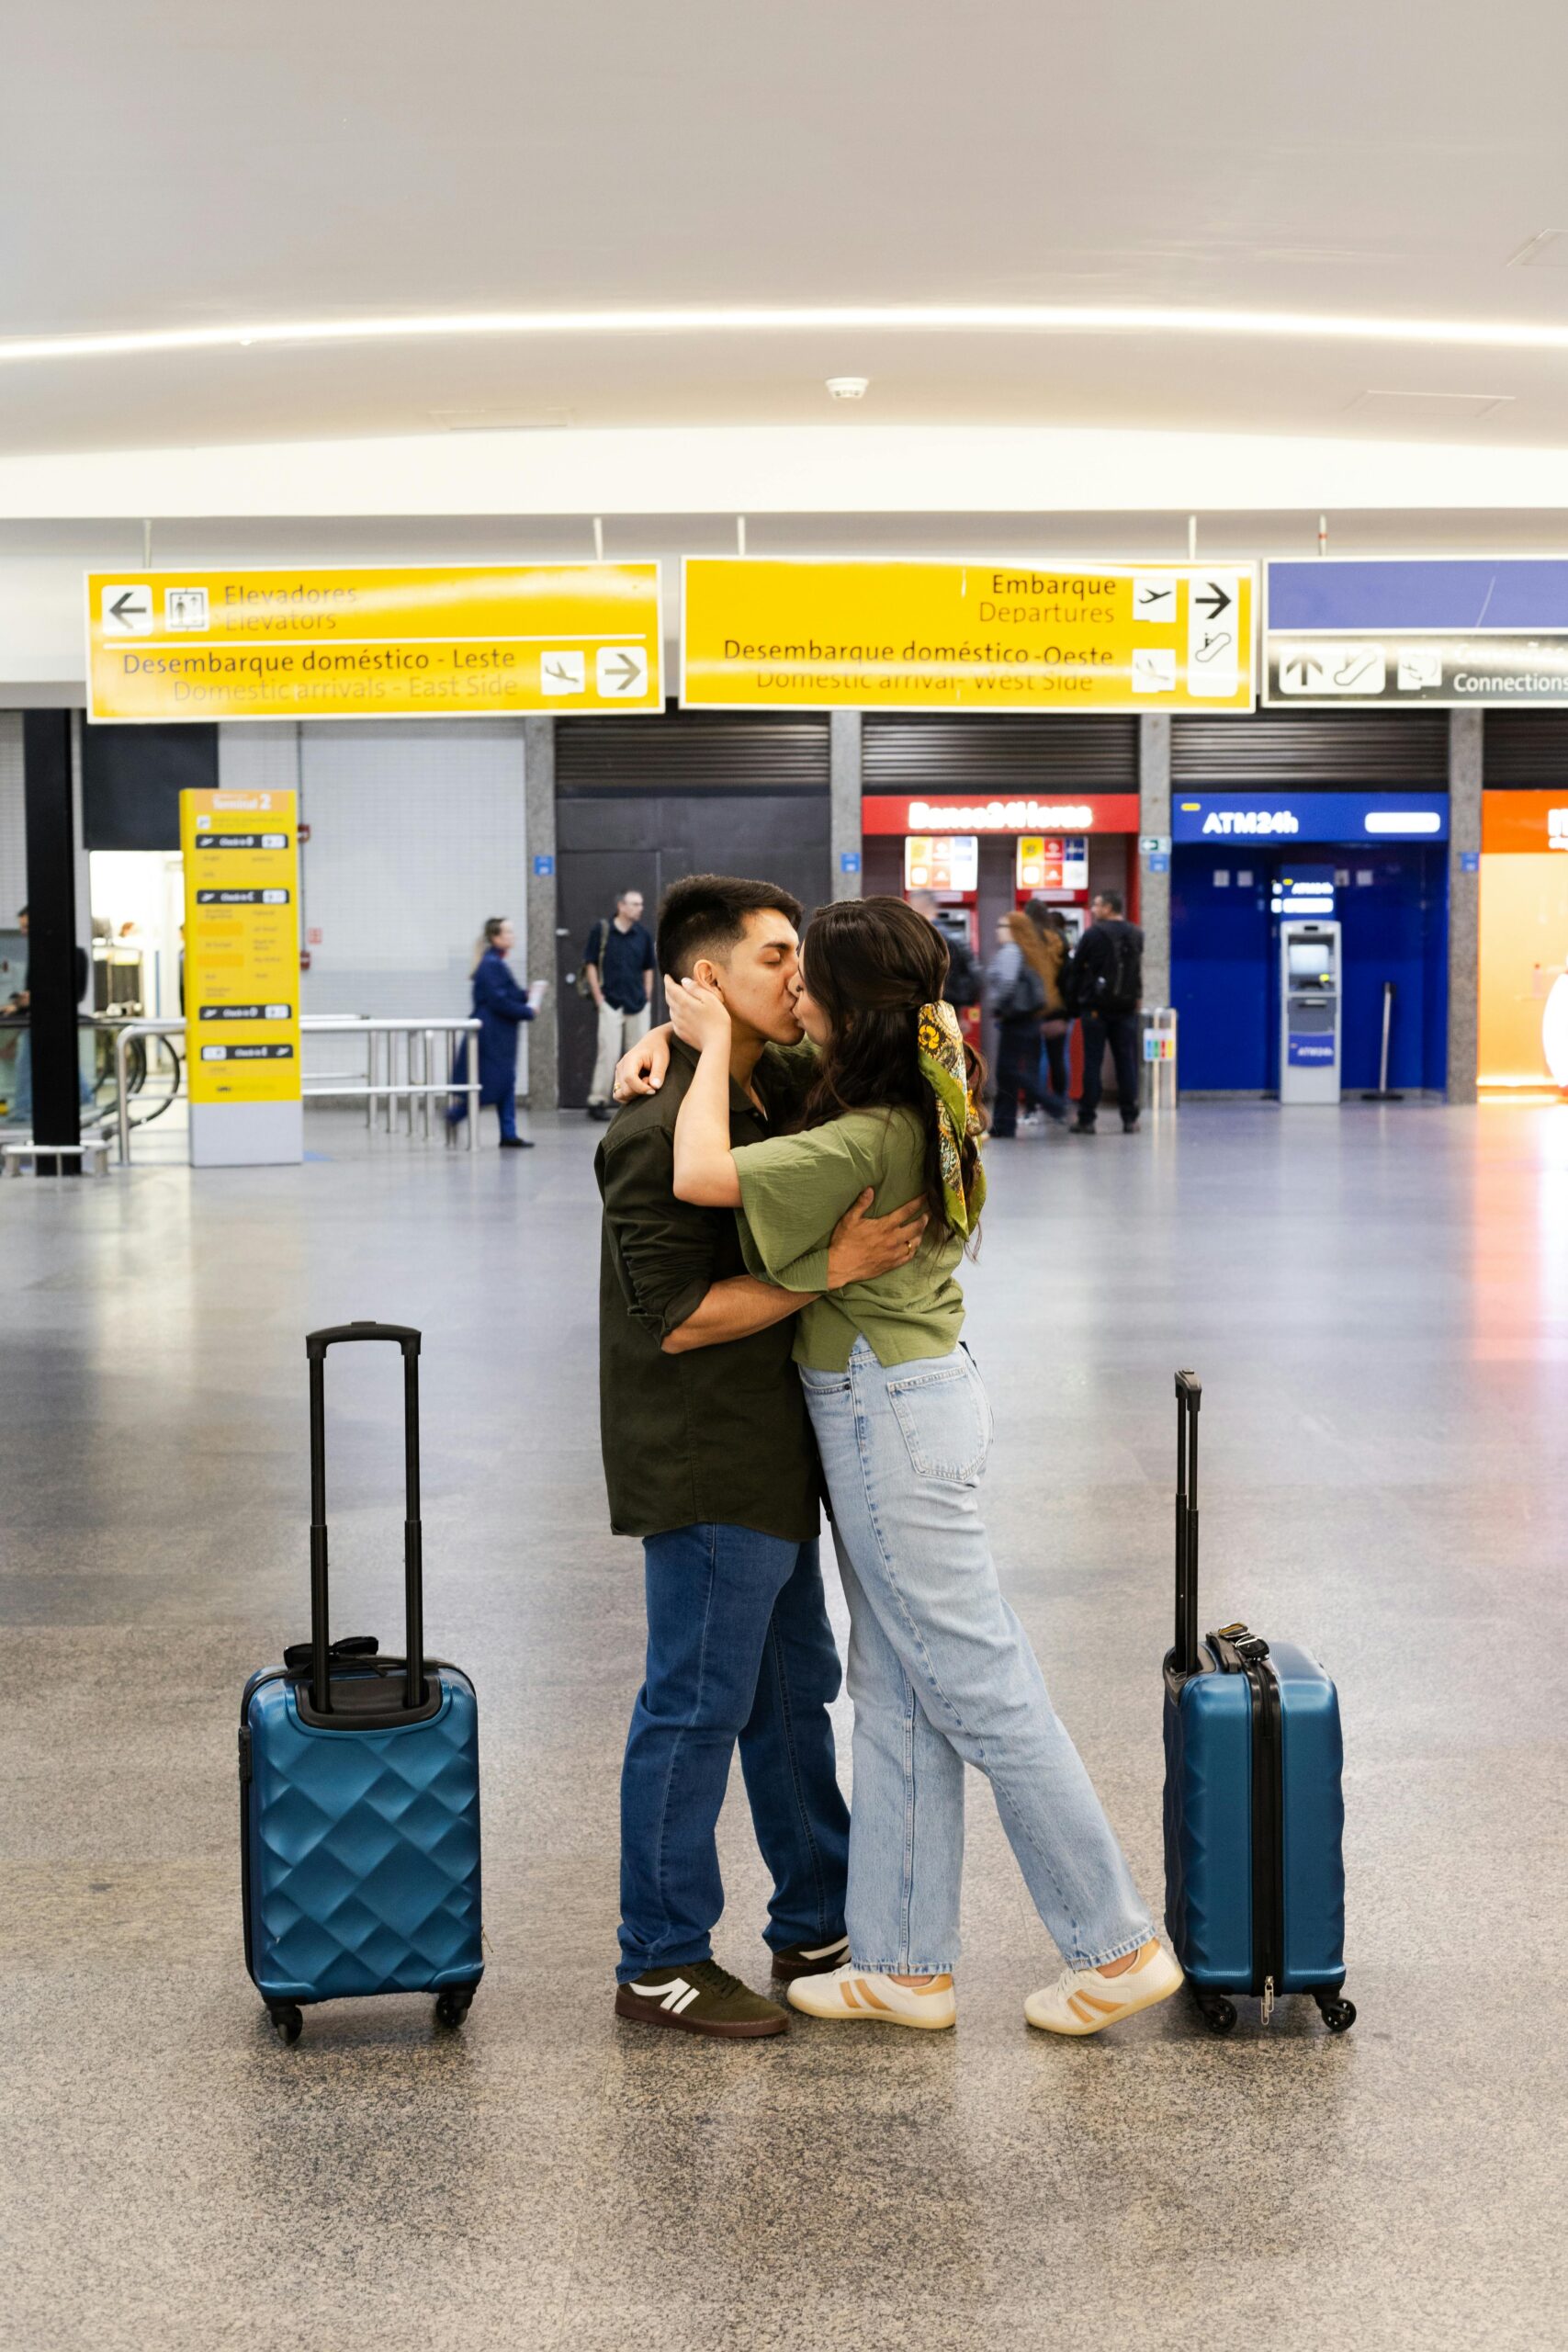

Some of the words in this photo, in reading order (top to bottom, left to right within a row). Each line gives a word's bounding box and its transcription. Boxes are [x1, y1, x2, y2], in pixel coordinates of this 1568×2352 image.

[224, 584, 357, 605] Elevadores
[993, 573, 1116, 601] Embarque
[225, 610, 337, 631] Elevators
[979, 602, 1115, 624] Departures
[123, 651, 294, 678] Desembarque
[301, 649, 429, 671] doméstico
[453, 649, 515, 669] Leste
[724, 639, 895, 666] Desembarque
[902, 640, 1029, 663] doméstico
[174, 679, 290, 702] Domestic
[297, 677, 386, 699] arrivals
[410, 675, 459, 698] East
[467, 674, 518, 697] Side
[757, 670, 873, 689] Domestic
[975, 671, 1035, 690] West
[1043, 671, 1094, 691] Side
[1453, 672, 1568, 693] Connections
[259, 793, 272, 810] 2
[1202, 810, 1299, 833] ATM24h
